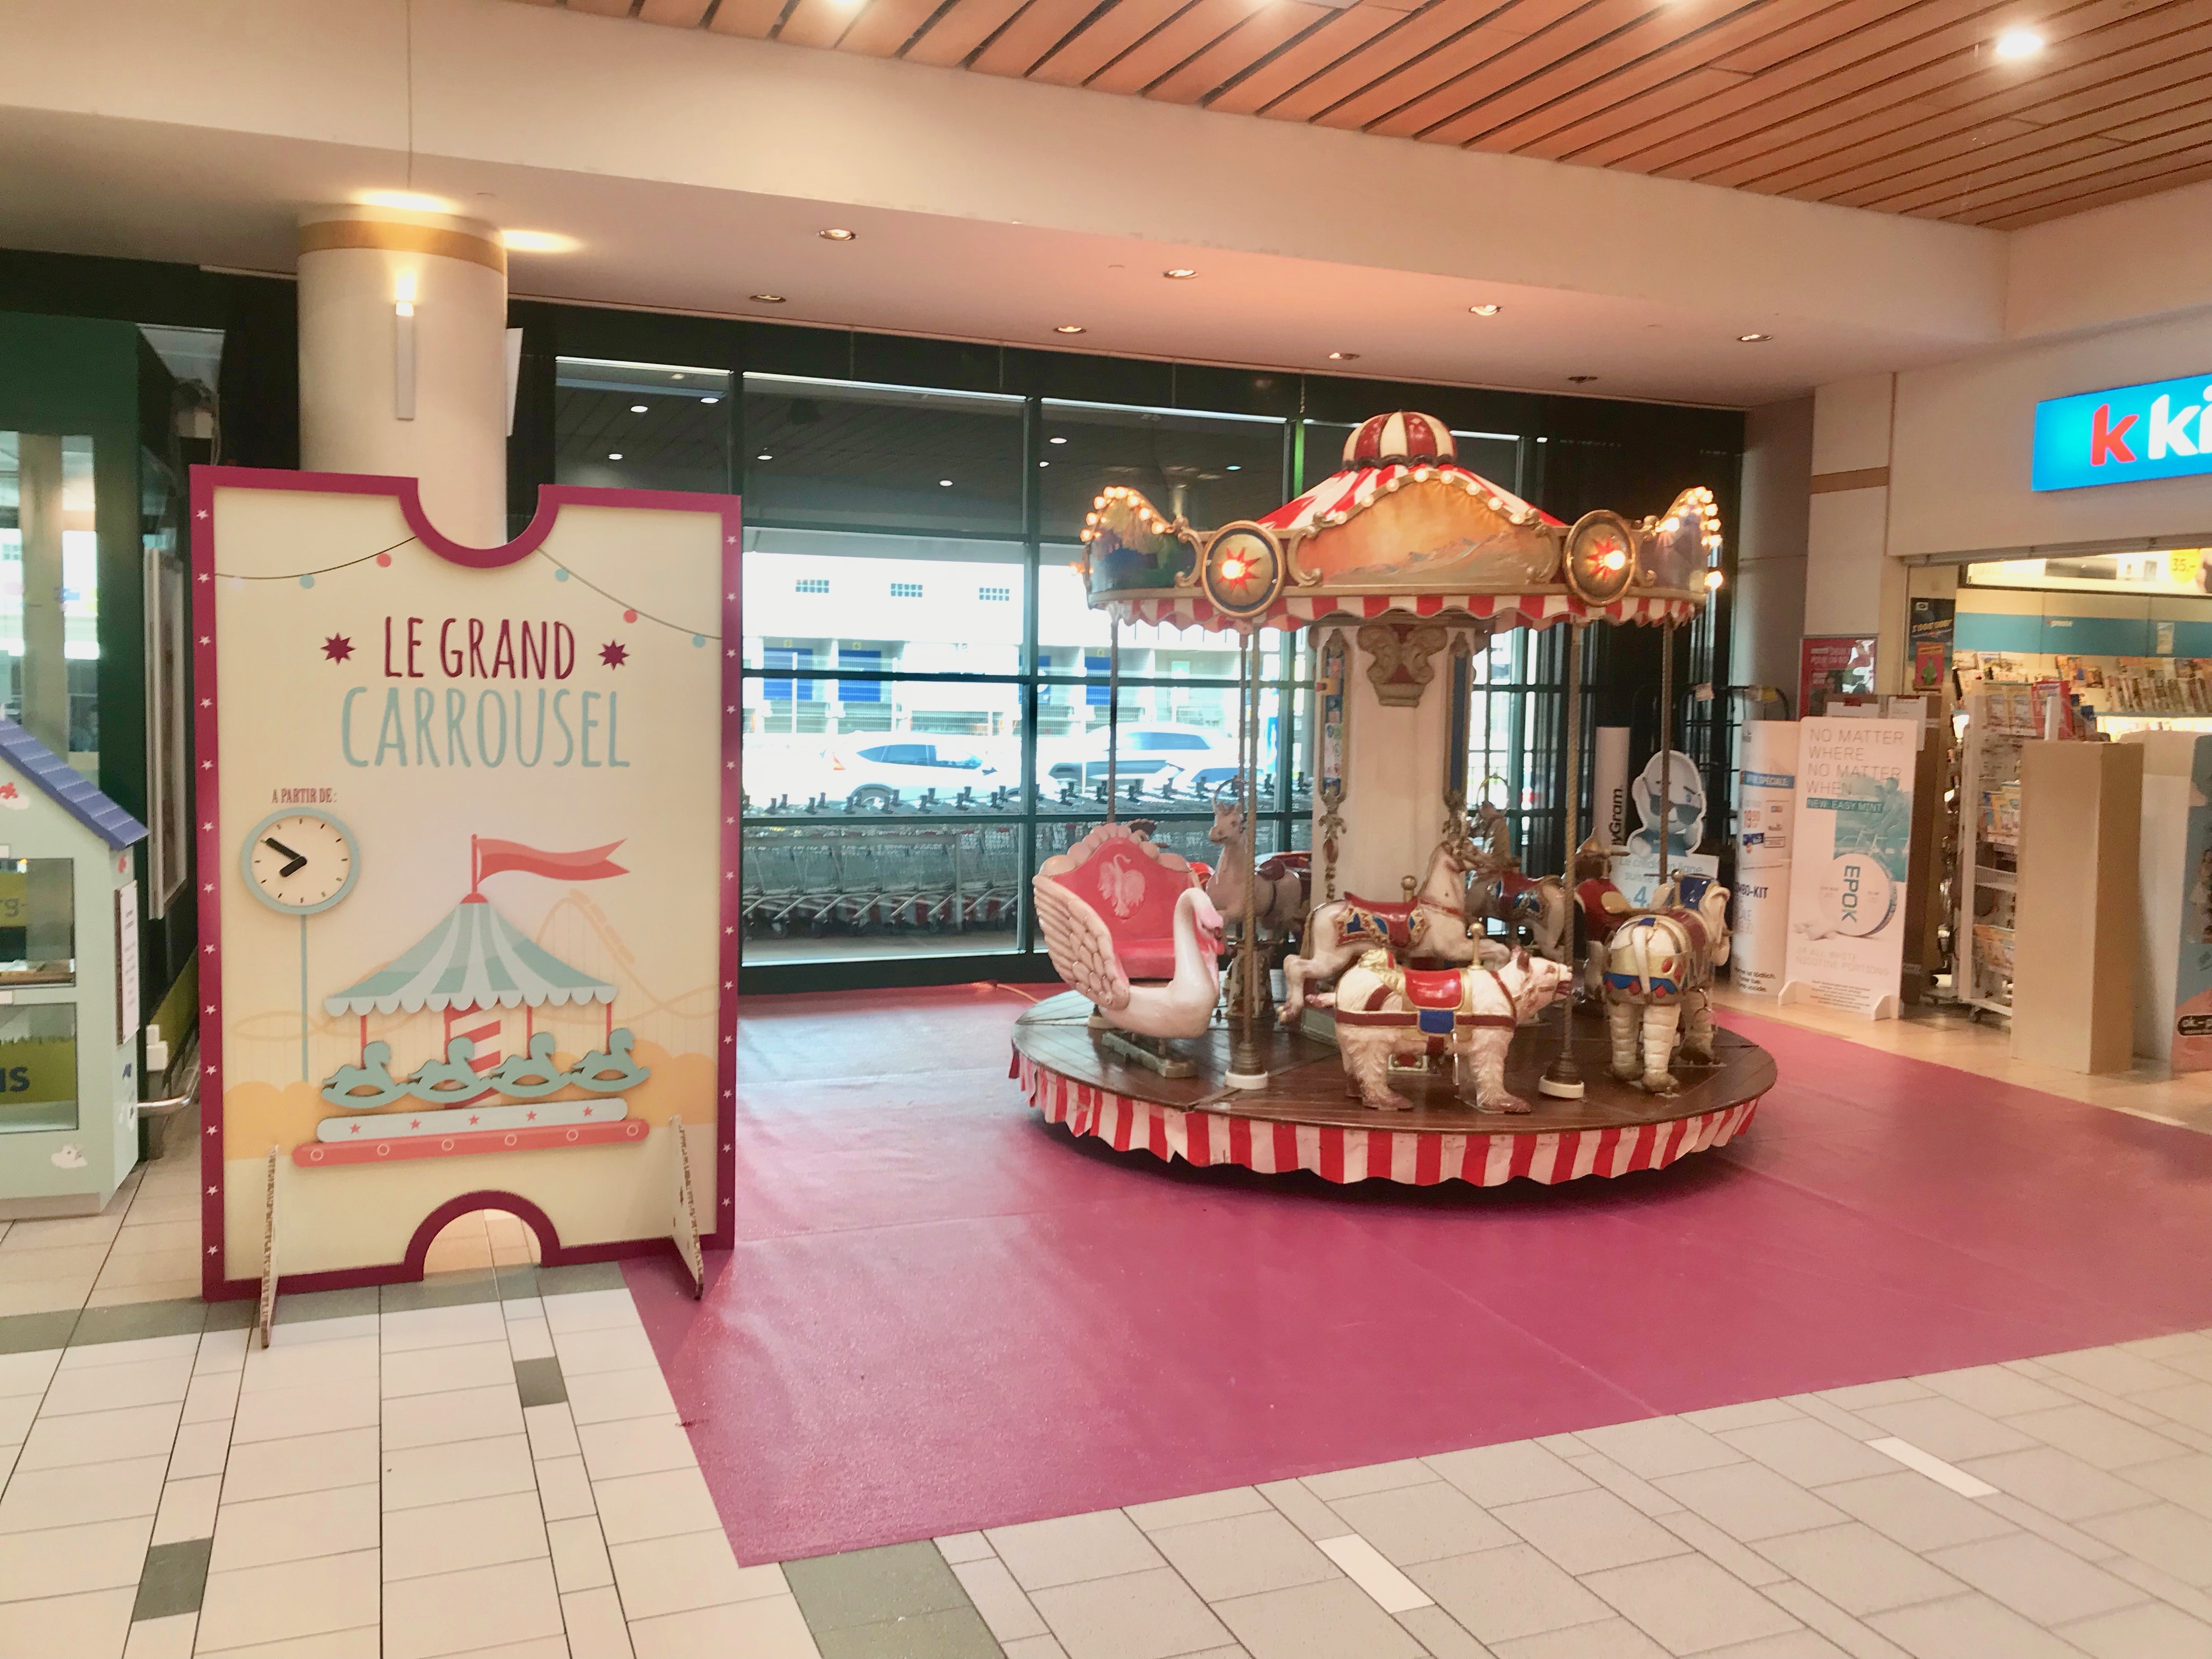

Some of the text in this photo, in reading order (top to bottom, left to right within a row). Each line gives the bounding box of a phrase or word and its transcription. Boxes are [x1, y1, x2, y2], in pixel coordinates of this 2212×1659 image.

[384, 616, 575, 680] LE GRAND
[341, 686, 630, 769] CARROUSEL
[1810, 729, 1905, 744] NO MATTER
[1808, 746, 1864, 761] WHERE
[1808, 763, 1903, 781] NO MATTER
[1806, 780, 1852, 795] WHEN
[271, 788, 278, 803] A
[281, 788, 317, 803] PARTIR
[1808, 799, 1882, 812] NEW EASY MINT
[1841, 865, 1860, 923] EPOK
